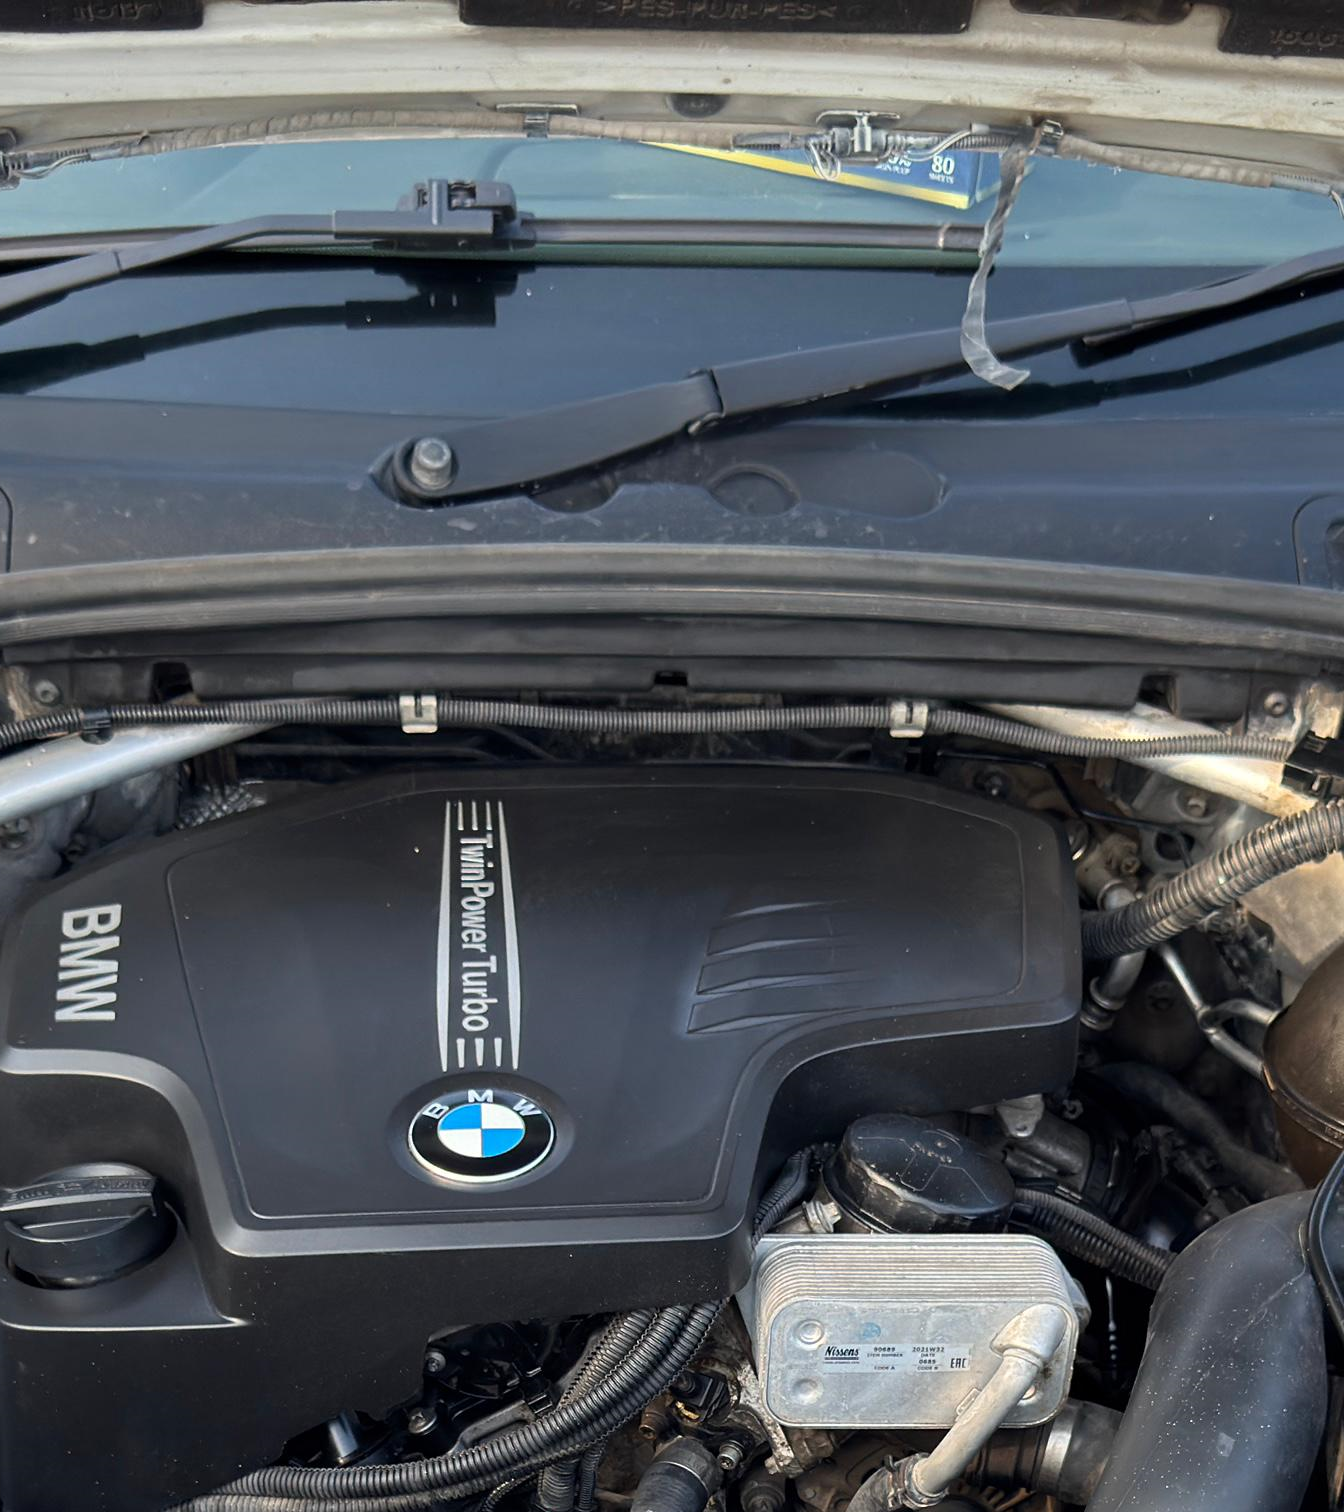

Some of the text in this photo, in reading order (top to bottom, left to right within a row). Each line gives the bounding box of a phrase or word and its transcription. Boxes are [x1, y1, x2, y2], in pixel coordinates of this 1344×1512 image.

[932, 155, 955, 175] 80
[457, 832, 499, 1032] TwinPower Turbo
[56, 902, 123, 1024] BMW
[422, 1088, 543, 1120] BMW
[824, 1345, 860, 1357] Nissens
